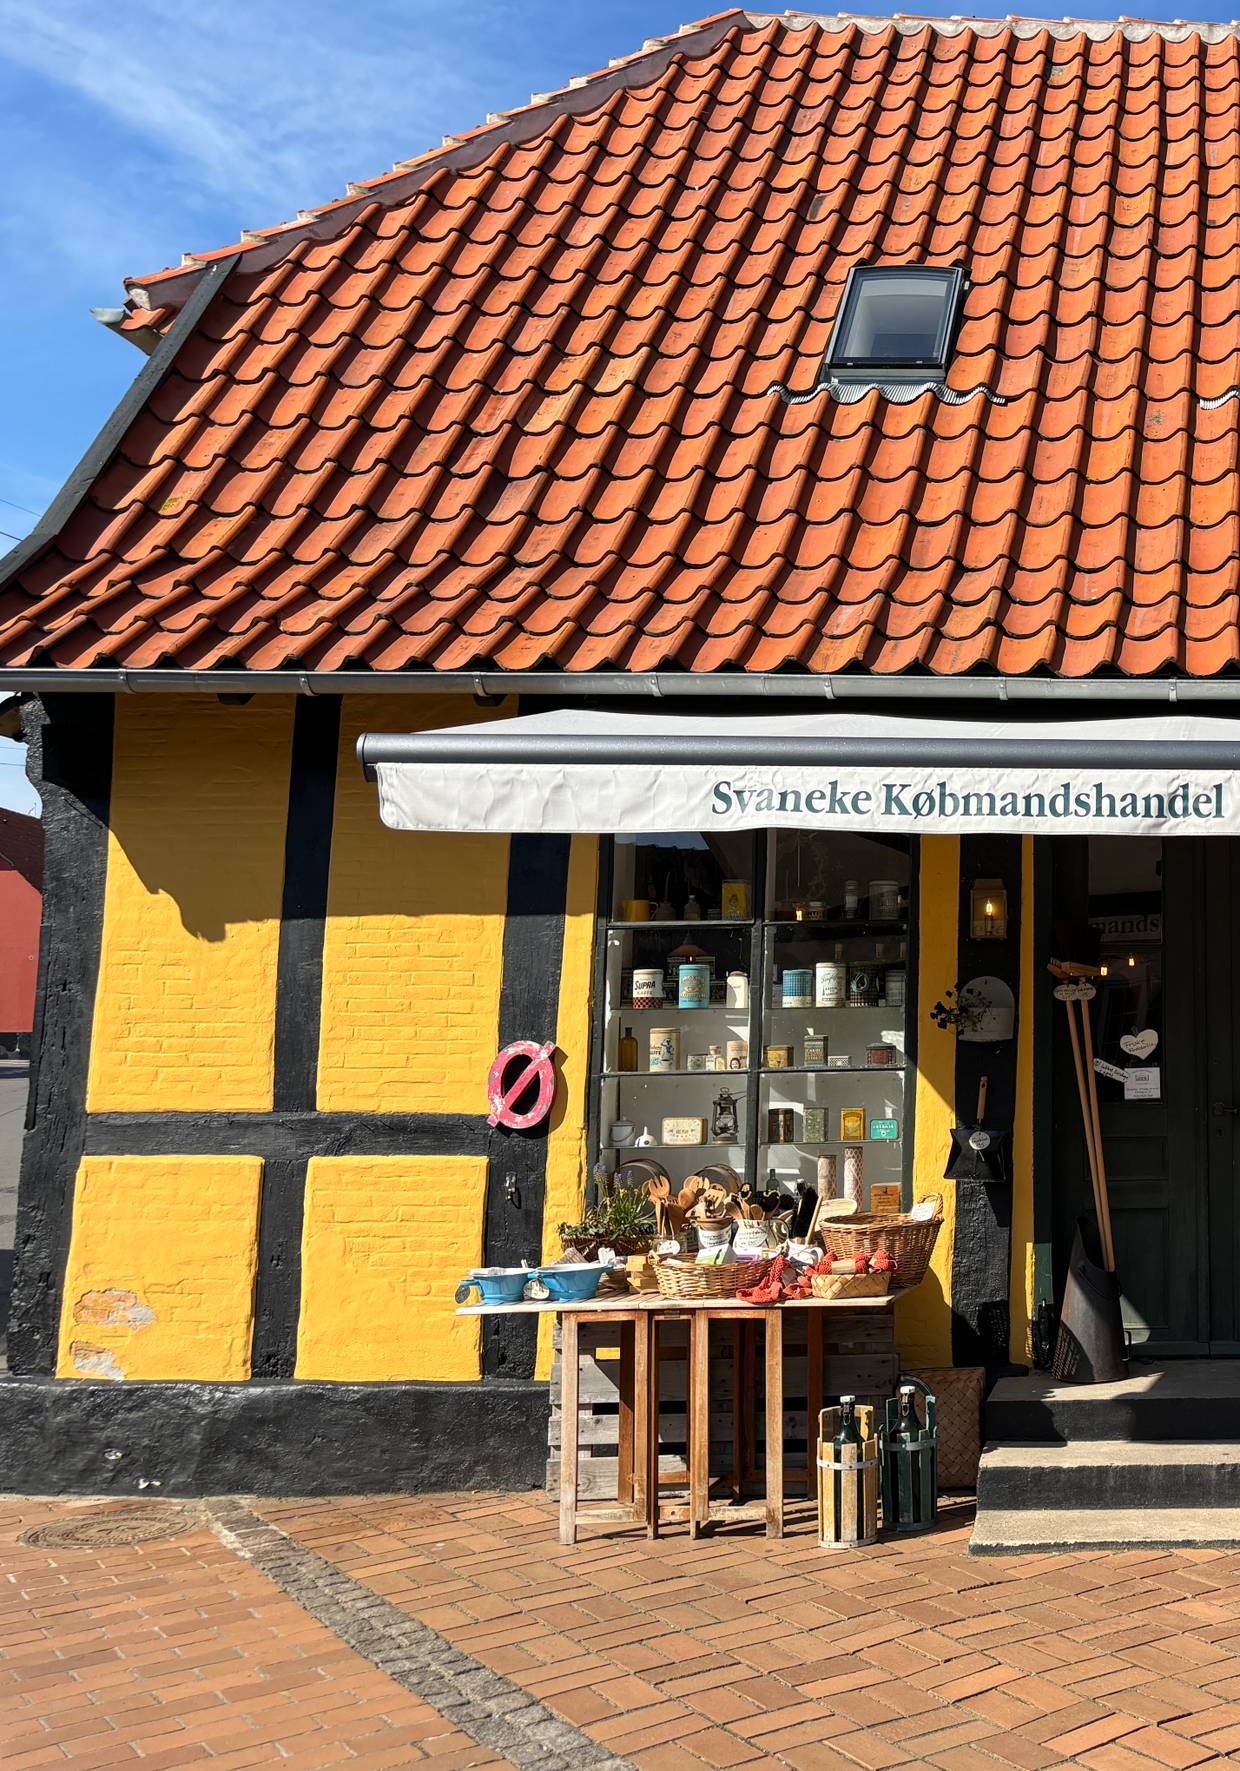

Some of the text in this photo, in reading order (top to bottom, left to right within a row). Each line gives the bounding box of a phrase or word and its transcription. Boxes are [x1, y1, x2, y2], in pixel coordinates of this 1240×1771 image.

[711, 780, 1225, 819] Svaneke Købmandshandel
[634, 980, 656, 990] SUPRA
